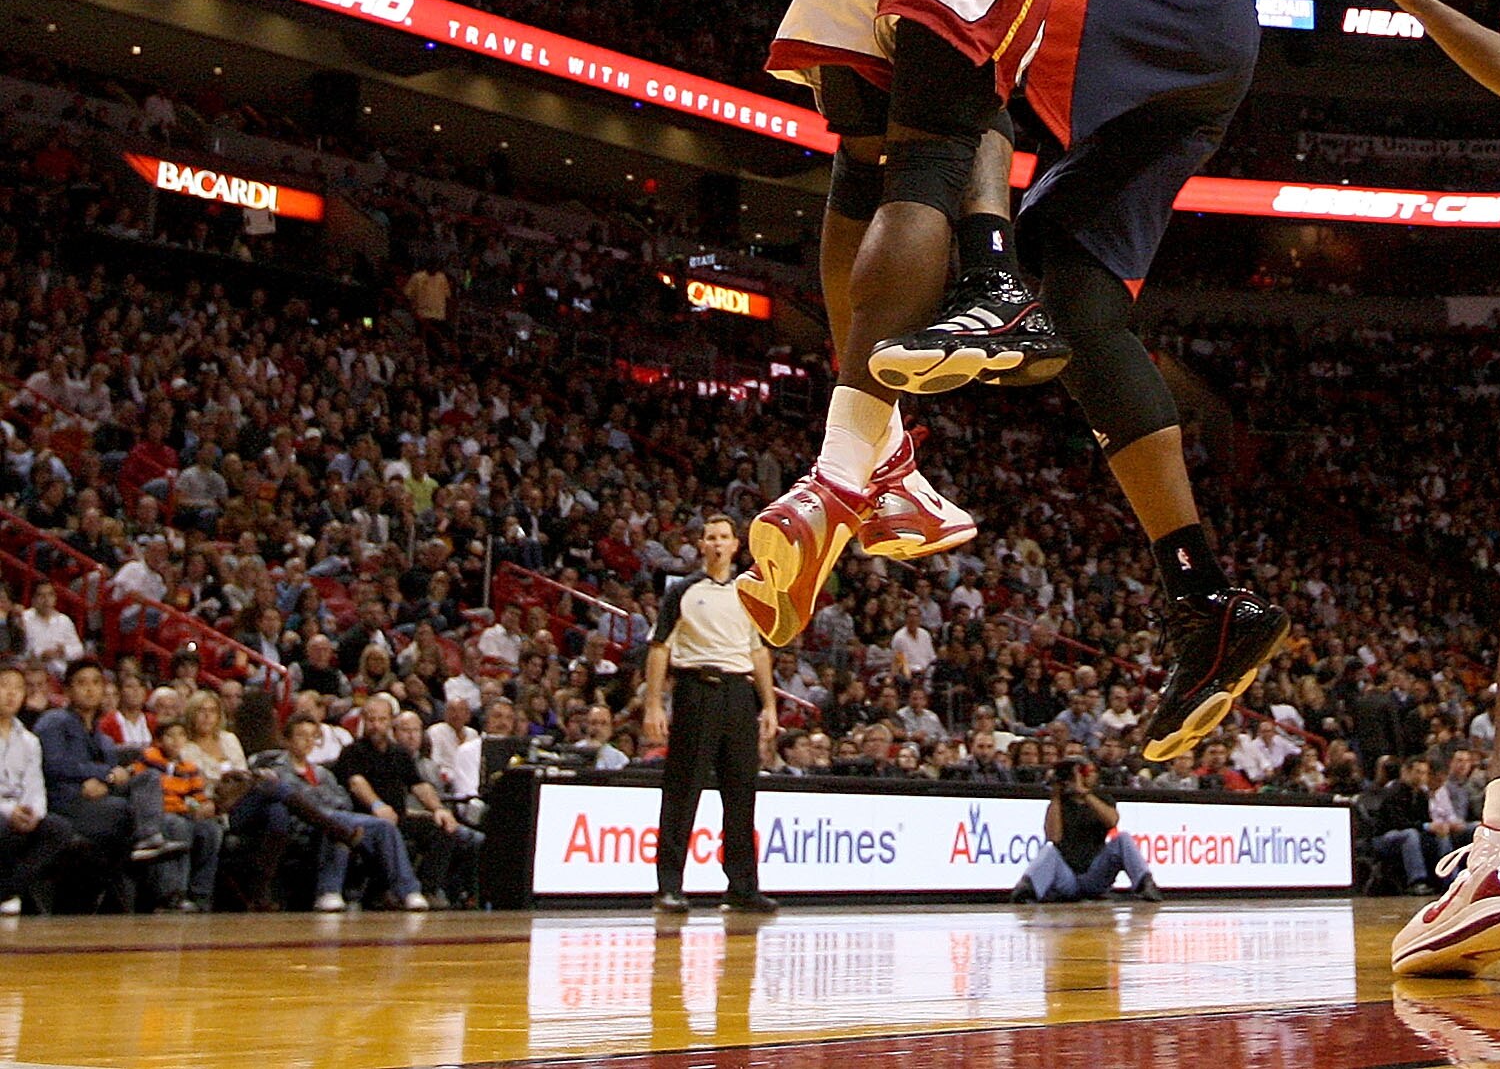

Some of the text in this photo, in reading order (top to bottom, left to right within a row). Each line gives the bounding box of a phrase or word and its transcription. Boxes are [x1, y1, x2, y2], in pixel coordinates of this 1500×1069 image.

[447, 19, 551, 68] TRAVEL
[567, 55, 630, 89] WITH
[646, 79, 799, 139] CONFIDENCE
[157, 160, 278, 211] BACARDI
[686, 280, 752, 315] CARDI
[949, 821, 1041, 864] AA.co
